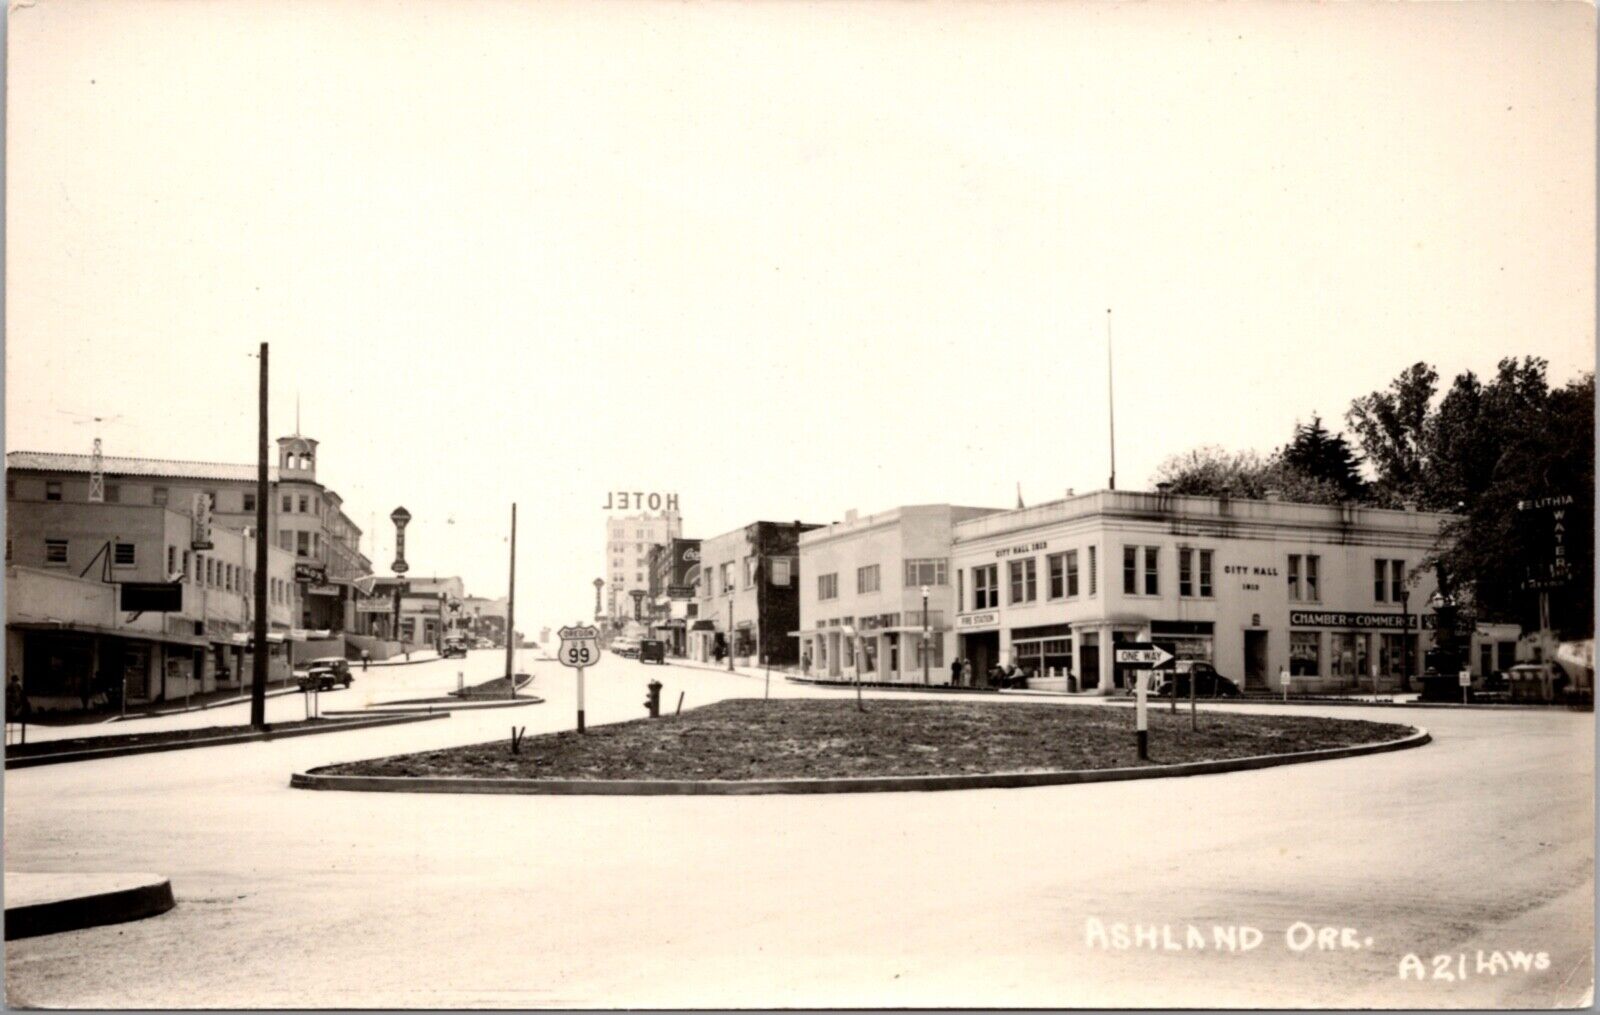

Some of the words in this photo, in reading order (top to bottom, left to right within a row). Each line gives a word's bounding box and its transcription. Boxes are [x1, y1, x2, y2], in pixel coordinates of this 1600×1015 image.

[1535, 494, 1573, 508] LITHIA
[1553, 510, 1566, 567] WATER
[996, 548, 1010, 557] CITY
[1013, 545, 1029, 554] HALL
[1224, 565, 1248, 575] CITY
[1253, 567, 1279, 576] HALL
[961, 616, 972, 625] FIRE
[974, 614, 994, 624] STATION
[1292, 612, 1347, 625] CHAMBER
[1355, 615, 1416, 626] COMMERE
[563, 629, 594, 638] OREGON
[569, 648, 589, 663] 99
[1121, 650, 1139, 661] ONE
[1144, 650, 1162, 661] WAY
